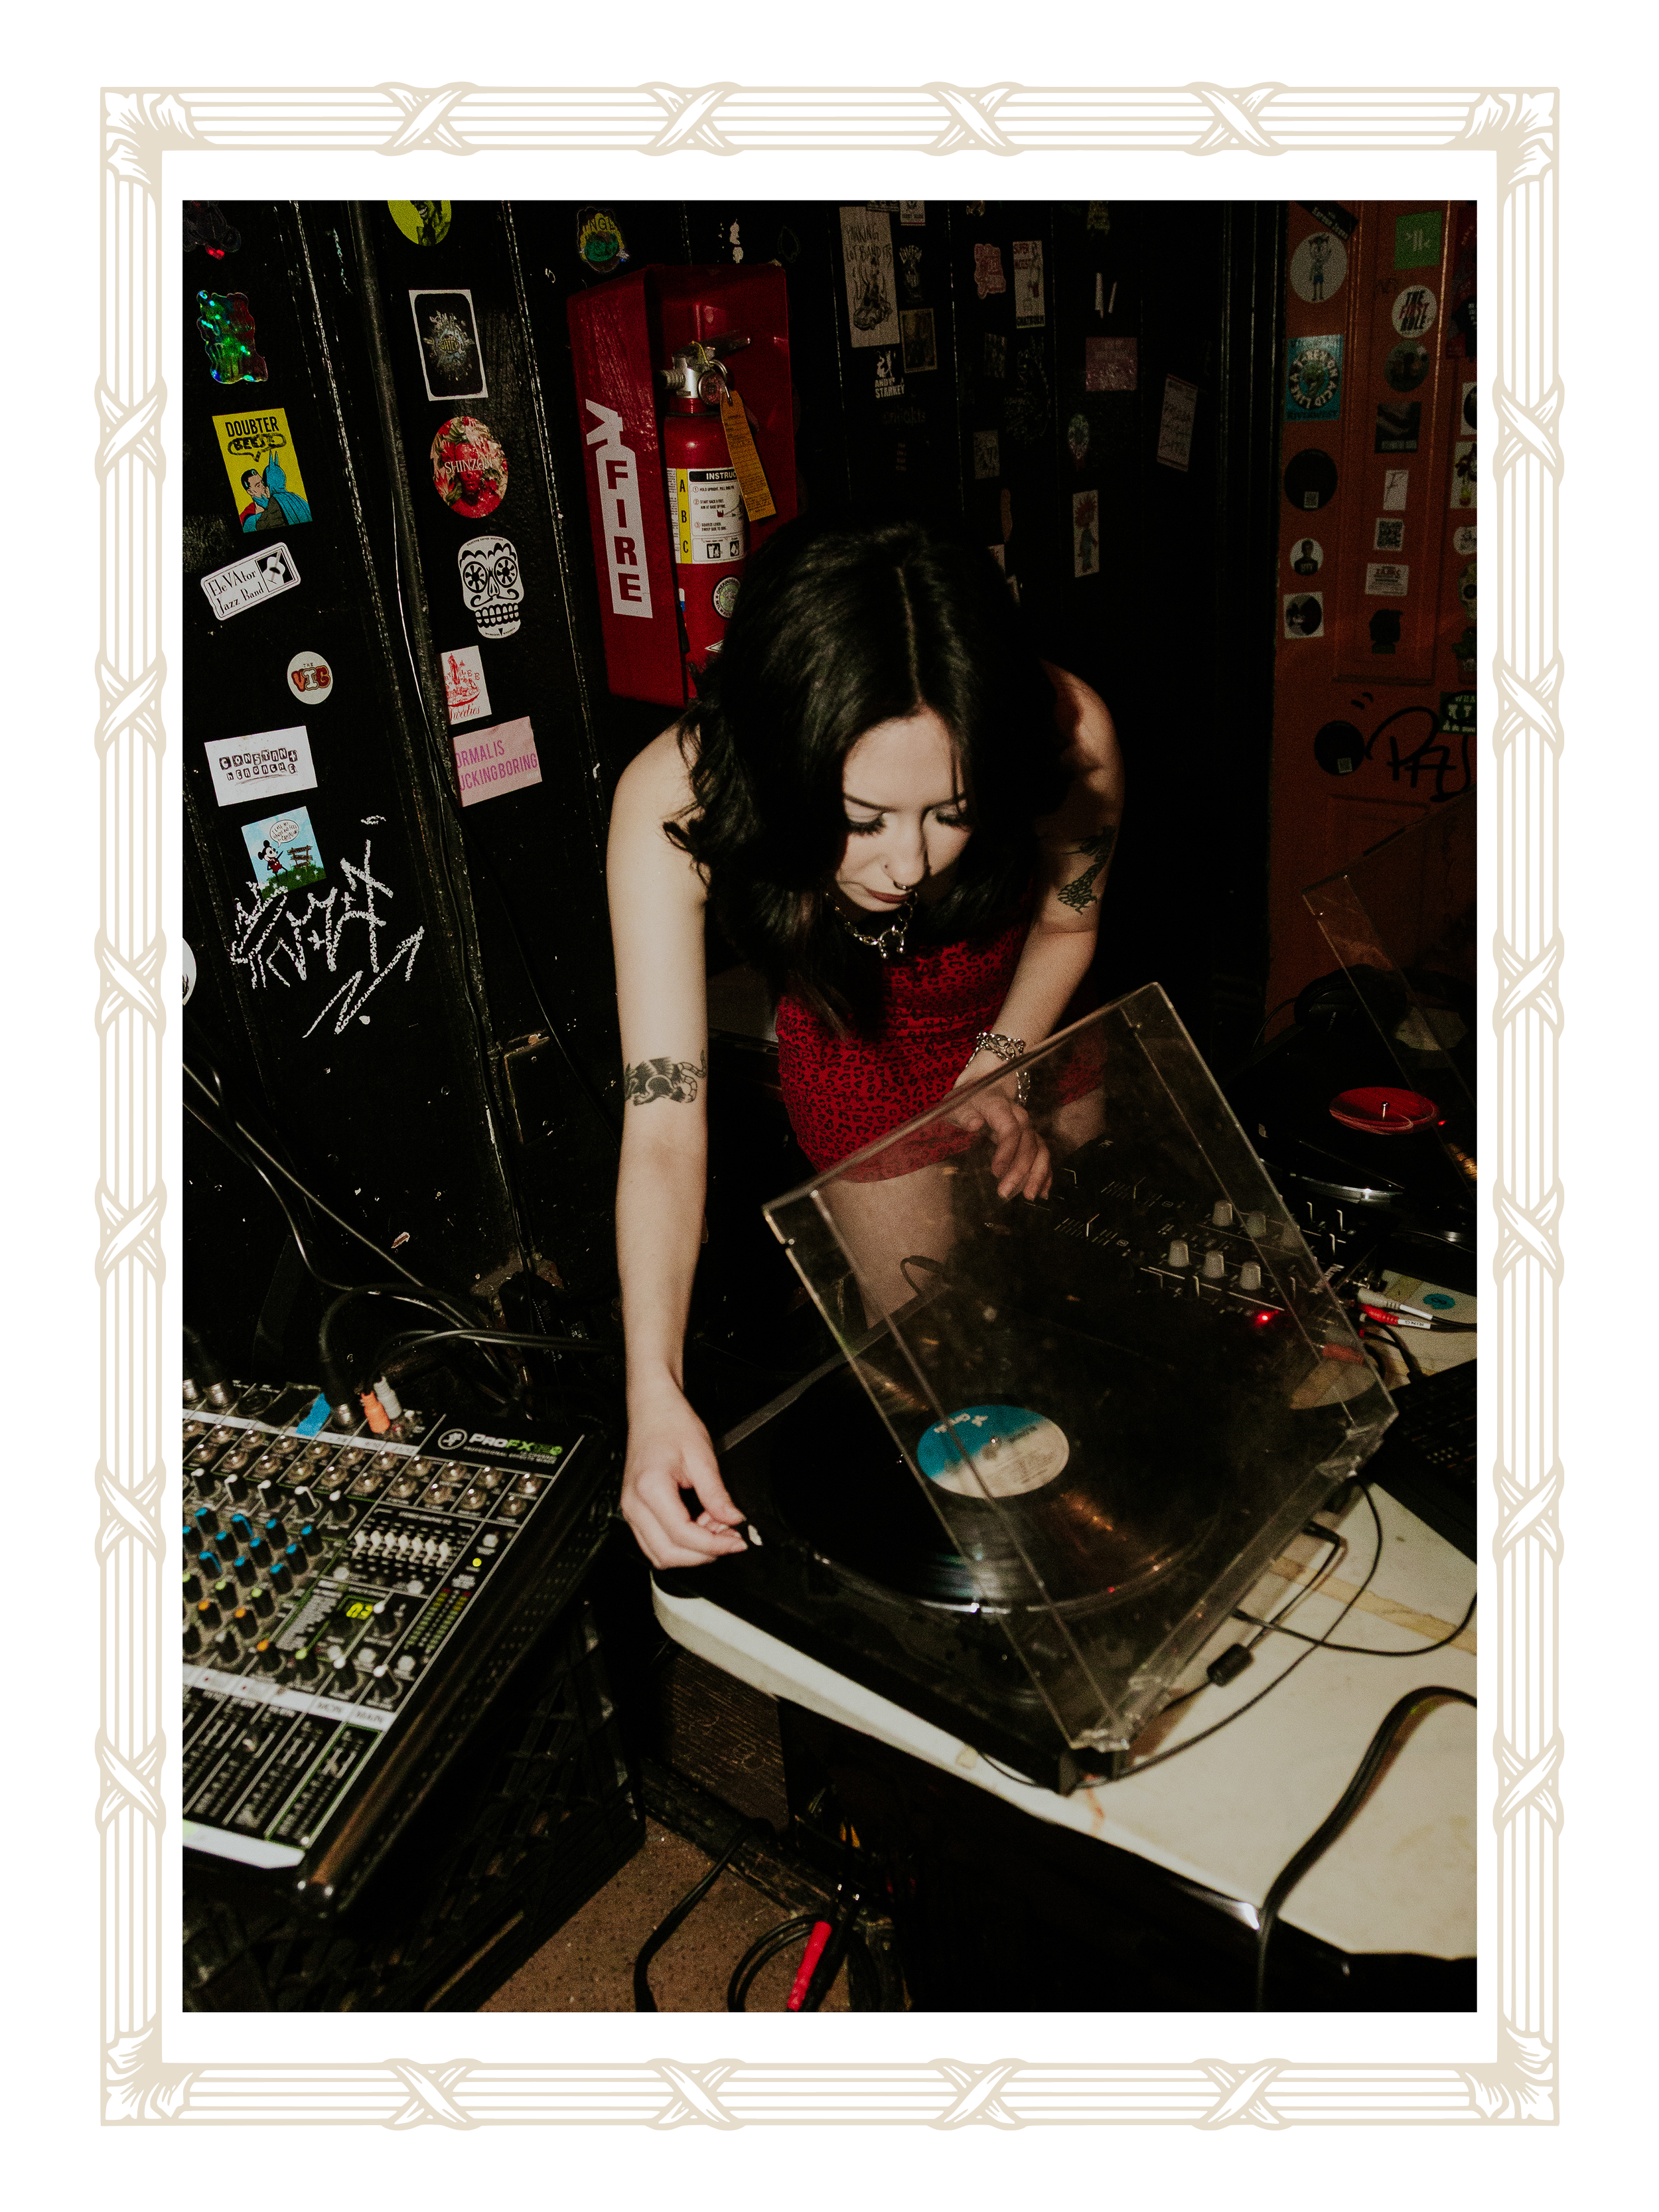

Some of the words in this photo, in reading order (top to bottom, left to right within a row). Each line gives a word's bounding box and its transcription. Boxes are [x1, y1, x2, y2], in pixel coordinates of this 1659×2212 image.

[1406, 290, 1425, 305] THE
[1400, 315, 1426, 331] RULE
[875, 384, 904, 399] STARKEY
[225, 416, 279, 437] DOUBTER
[444, 458, 493, 474] SHINZON
[680, 479, 685, 492] A
[681, 510, 687, 523] B
[605, 460, 642, 603] FIRE
[683, 540, 689, 553] C
[216, 597, 240, 616] Jazz
[240, 581, 265, 601] Band
[291, 665, 331, 692] VIG
[494, 739, 505, 758] IS
[498, 753, 538, 779] BORING
